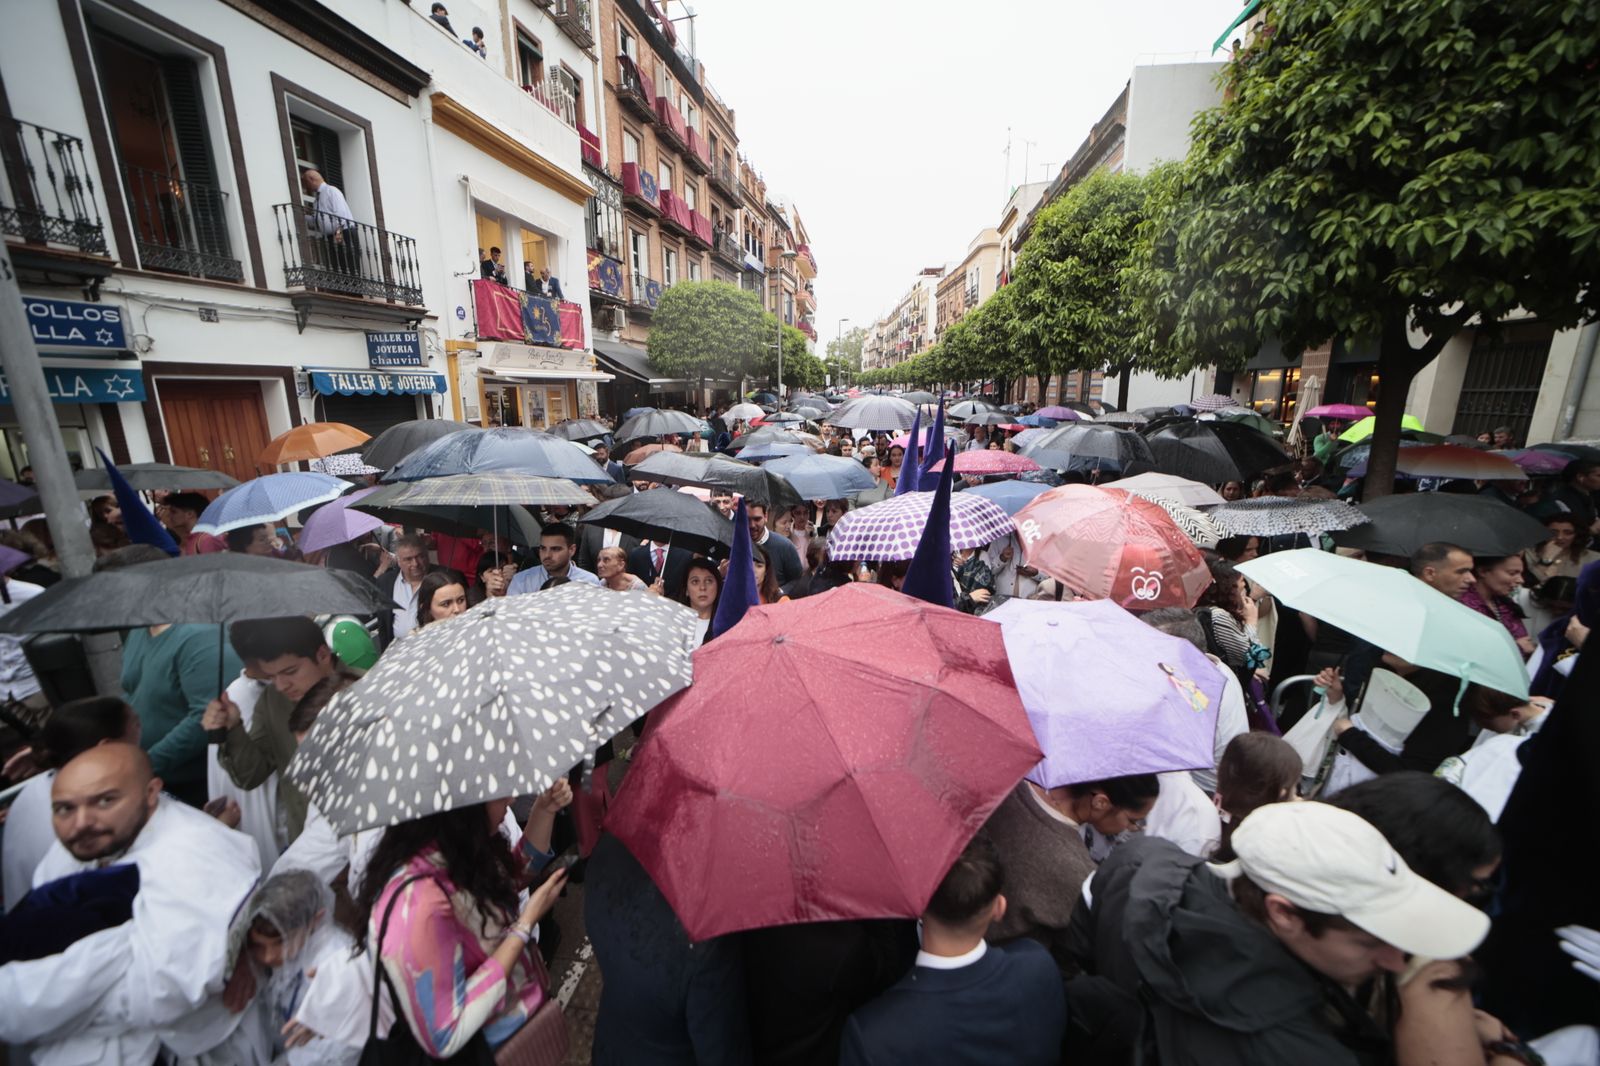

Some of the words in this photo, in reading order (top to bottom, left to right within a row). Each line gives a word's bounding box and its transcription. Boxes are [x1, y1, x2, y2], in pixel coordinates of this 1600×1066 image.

[22, 302, 120, 323] OLLOS
[32, 324, 87, 341] LLA
[368, 333, 402, 343] TALLER
[404, 333, 417, 342] DE
[375, 344, 414, 354] JOYERIA
[371, 354, 421, 366] chauvin
[328, 373, 376, 391] TALLER
[378, 374, 394, 391] DE
[397, 375, 437, 390] JOYERIA
